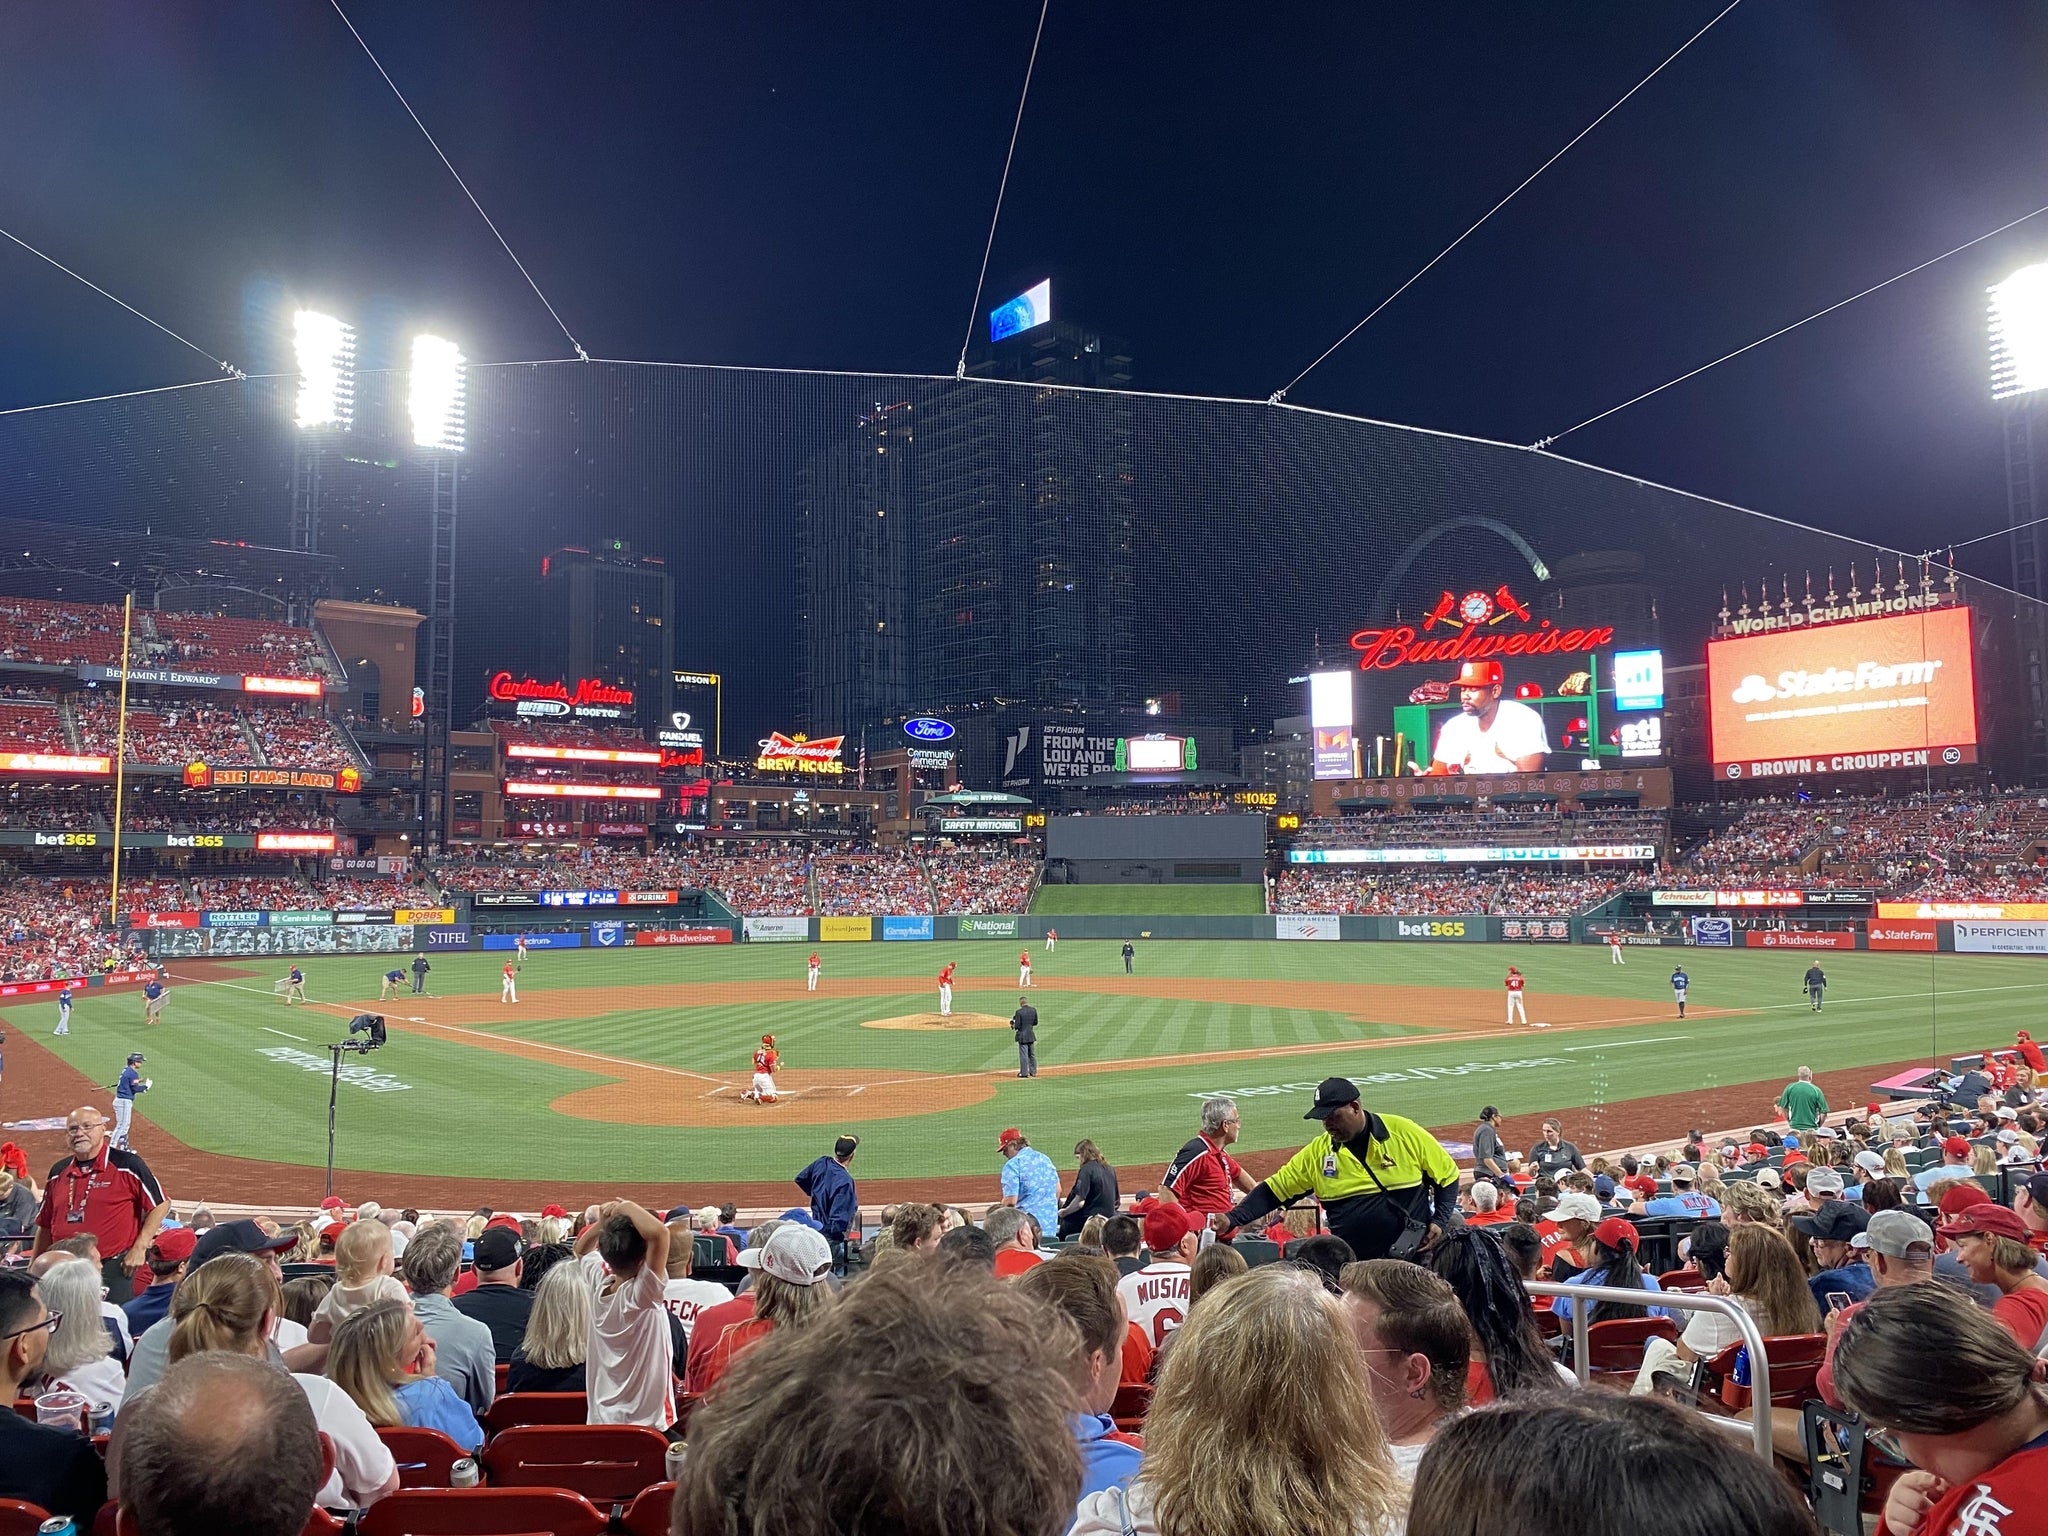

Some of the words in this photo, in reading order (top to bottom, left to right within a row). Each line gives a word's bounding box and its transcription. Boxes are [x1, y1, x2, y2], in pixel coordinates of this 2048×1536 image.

[1731, 612, 1804, 635] WORLD
[1808, 593, 1940, 624] CHAMPIONS
[1350, 619, 1614, 671] Budweiser
[170, 672, 218, 685] EDWARDS
[675, 675, 709, 684] LARSON
[490, 671, 568, 701] Cardinals
[568, 678, 633, 705] Nation
[575, 708, 620, 717] ROOFTOP
[914, 720, 945, 736] Ford
[660, 732, 702, 742] FANDUEL
[758, 739, 842, 758] Budweiser
[1043, 735, 1084, 750] FROM
[1088, 737, 1115, 751] THE
[907, 748, 955, 761] Community
[1043, 750, 1071, 763] LOU
[1074, 751, 1105, 764] AND
[757, 757, 796, 772] BREW
[799, 759, 843, 774] HOUSE
[1043, 762, 1089, 776] WE'RE
[1751, 759, 1812, 777] BROWN
[1815, 761, 1827, 772] &
[1831, 750, 1928, 771] CROUPPEN
[213, 771, 247, 785] BIG
[249, 770, 289, 785] MAC
[291, 771, 334, 788] LAND
[1234, 793, 1277, 805] SMOKE
[944, 821, 975, 830] SAFETY
[976, 821, 1017, 830] NATIONAL
[35, 832, 97, 846] bet365
[167, 833, 224, 848] bet365
[390, 863, 402, 871] 27
[1657, 892, 1711, 901] Schnucks
[1808, 894, 1828, 903] Mercy
[211, 913, 258, 921] ROTTLER
[311, 914, 332, 922] Bank
[593, 921, 622, 929] CarShield
[759, 923, 784, 931] Ameren
[973, 920, 1016, 931] National
[1399, 921, 1465, 937] bet365
[1703, 920, 1724, 931] Ford
[429, 931, 468, 944] STIFEL
[1971, 928, 2046, 937] PERFICIENT
[514, 937, 548, 947] Sectrum
[669, 934, 717, 943] Budweiser
[1628, 937, 1661, 945] STADIUM
[1779, 935, 1837, 946] Budweiser
